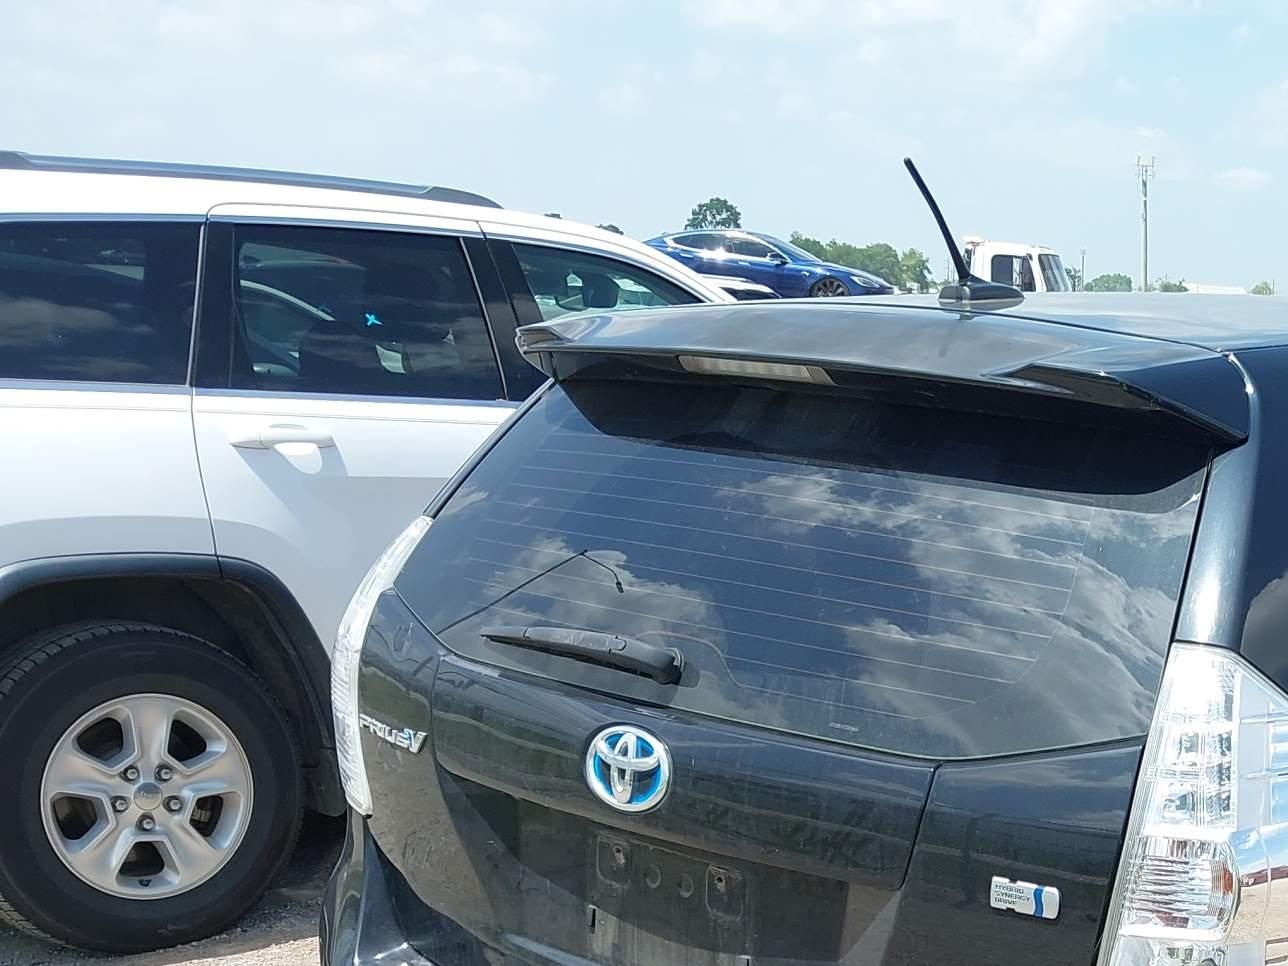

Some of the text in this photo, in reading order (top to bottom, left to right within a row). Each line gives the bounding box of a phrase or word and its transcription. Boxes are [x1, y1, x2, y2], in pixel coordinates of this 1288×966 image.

[995, 883, 1025, 895] HYBRID
[994, 890, 1031, 903] SYNERGY
[994, 897, 1018, 907] DRIVE
